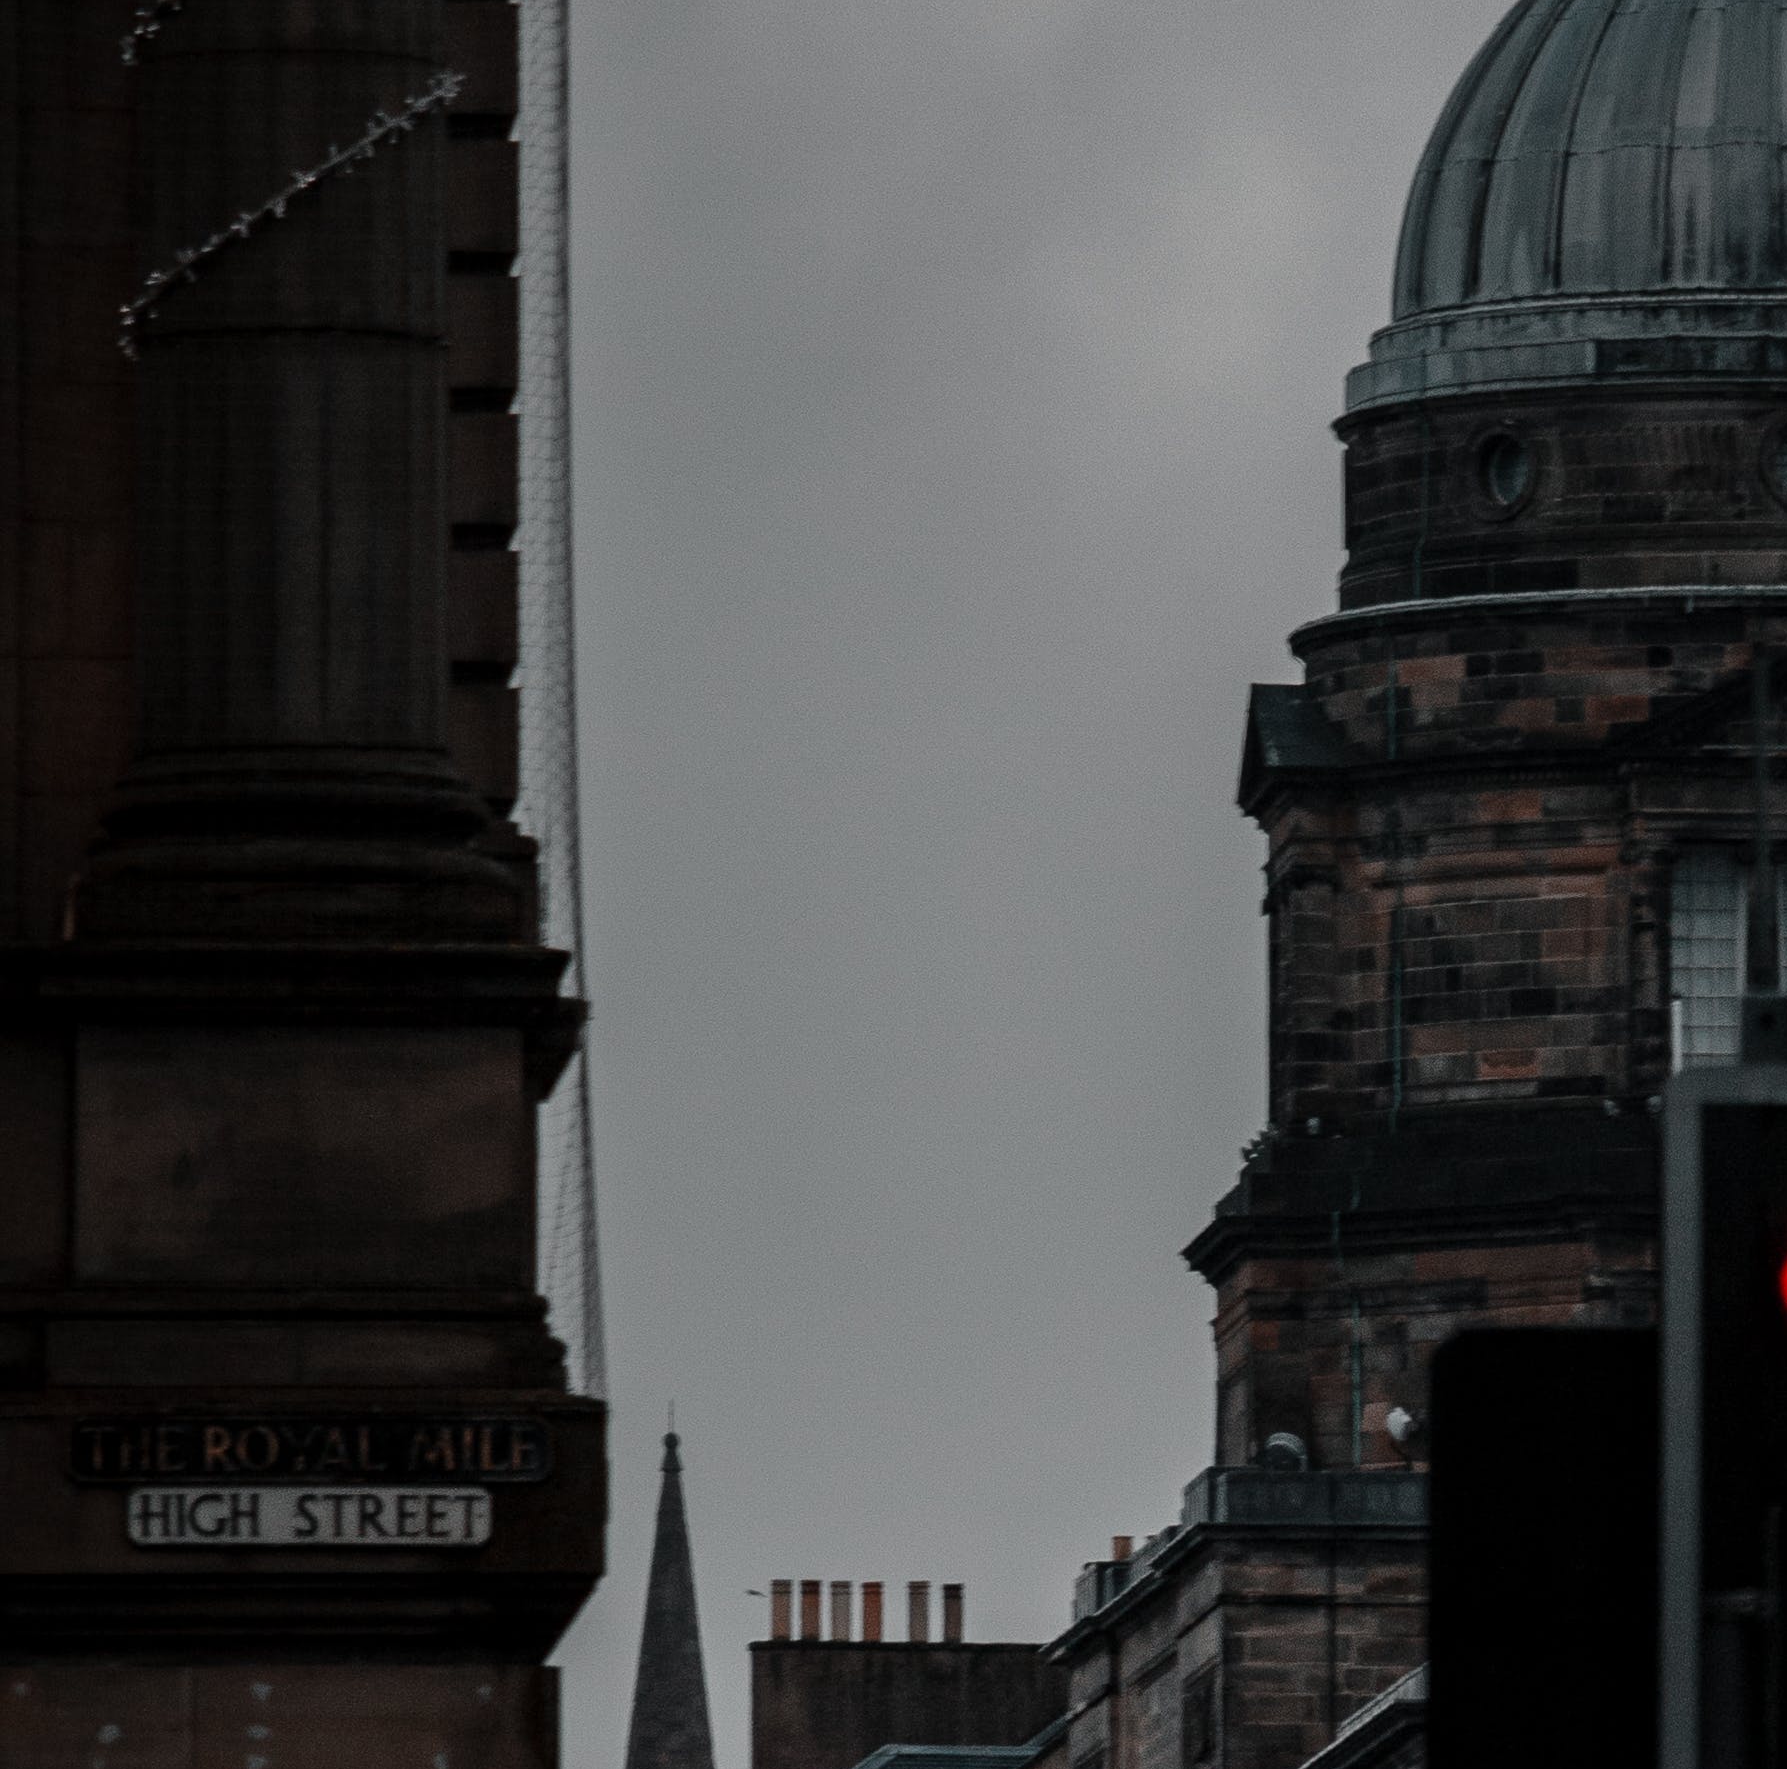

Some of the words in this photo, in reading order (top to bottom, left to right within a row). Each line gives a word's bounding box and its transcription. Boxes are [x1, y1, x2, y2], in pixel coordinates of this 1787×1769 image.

[80, 1425, 190, 1473] THE
[201, 1424, 387, 1472] ROYAL
[410, 1424, 537, 1472] MILE
[139, 1492, 261, 1537] HIGH
[294, 1492, 488, 1538] STREET
